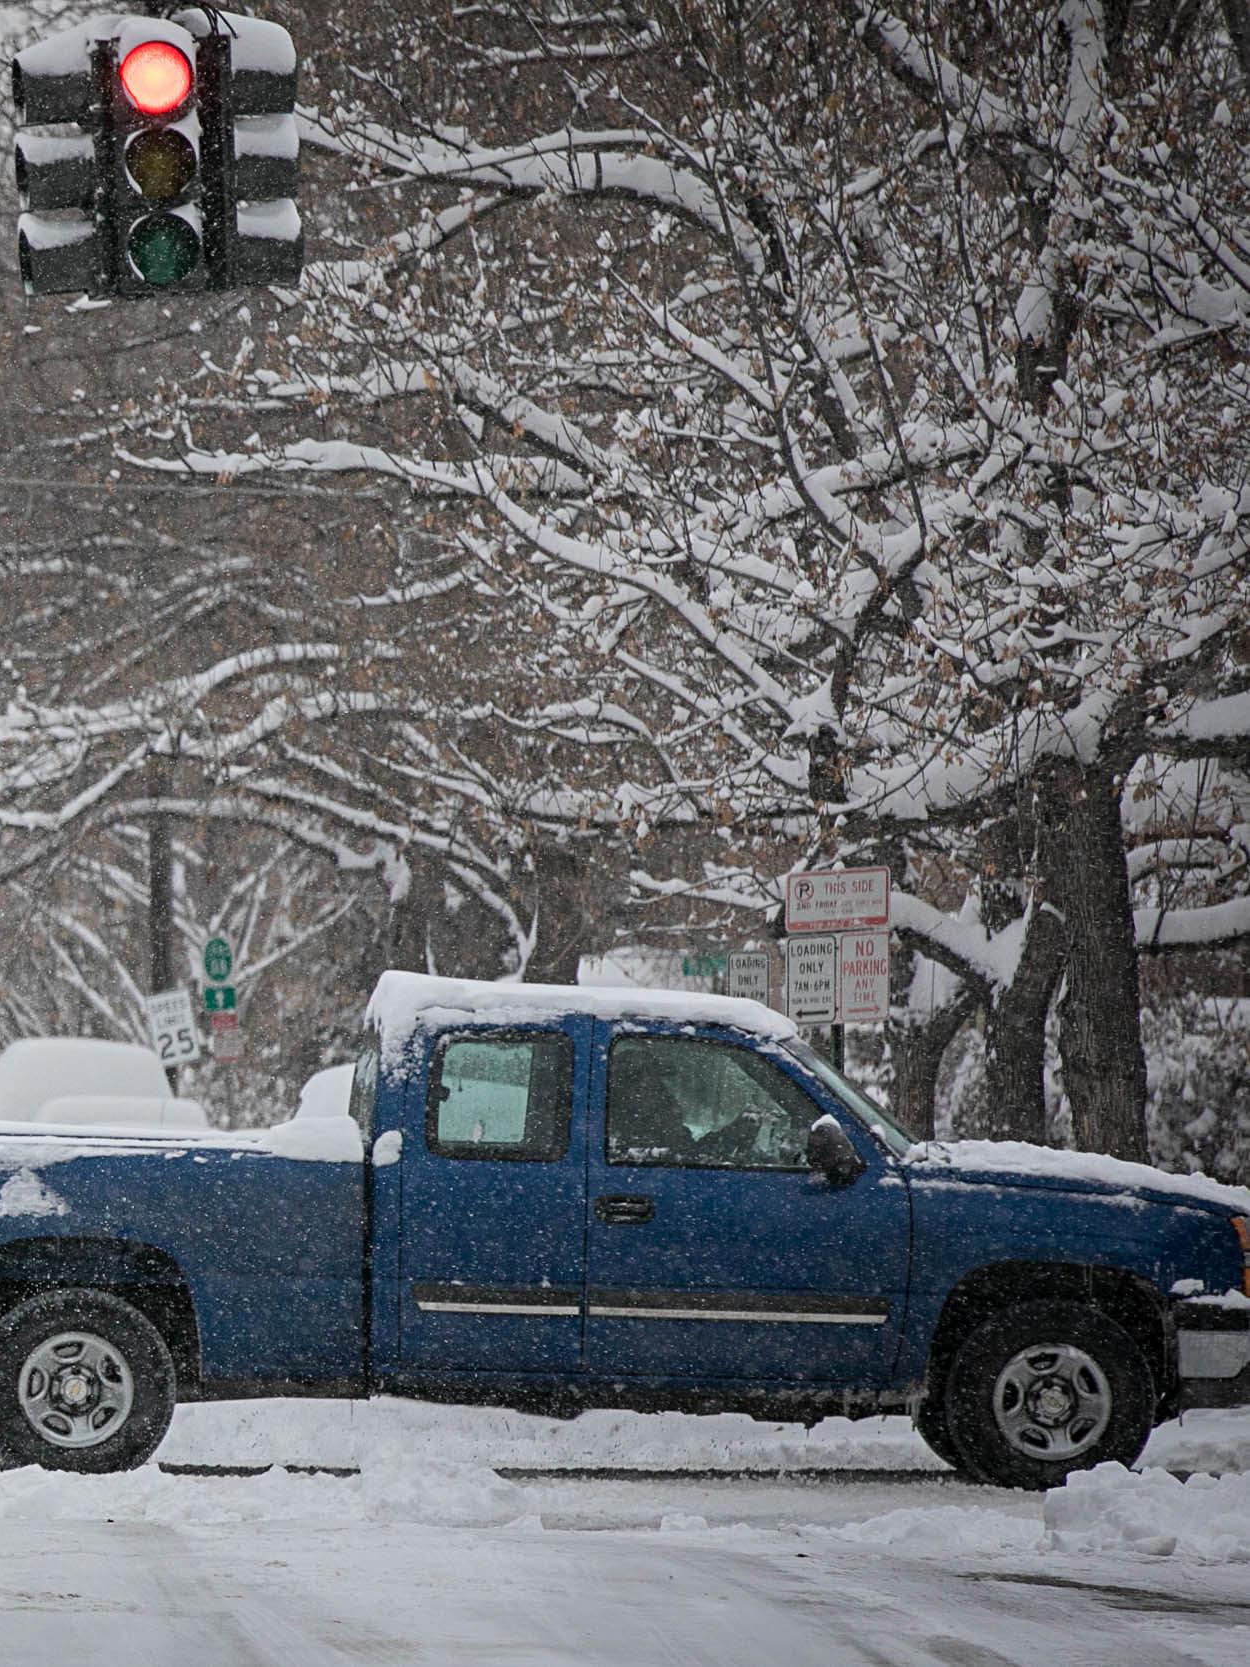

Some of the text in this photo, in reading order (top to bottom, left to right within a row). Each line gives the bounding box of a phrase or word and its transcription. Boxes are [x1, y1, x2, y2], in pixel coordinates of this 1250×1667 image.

[824, 880, 874, 895] THIS SIDE
[790, 943, 833, 957] LOADING
[855, 940, 875, 956] NO
[731, 959, 766, 969] LOADING
[799, 962, 824, 974] ONLY
[843, 959, 887, 976] PARKING
[738, 975, 759, 986] ONLY
[854, 979, 875, 990] ANY
[854, 991, 876, 1003] TIME
[158, 1028, 194, 1060] 25
